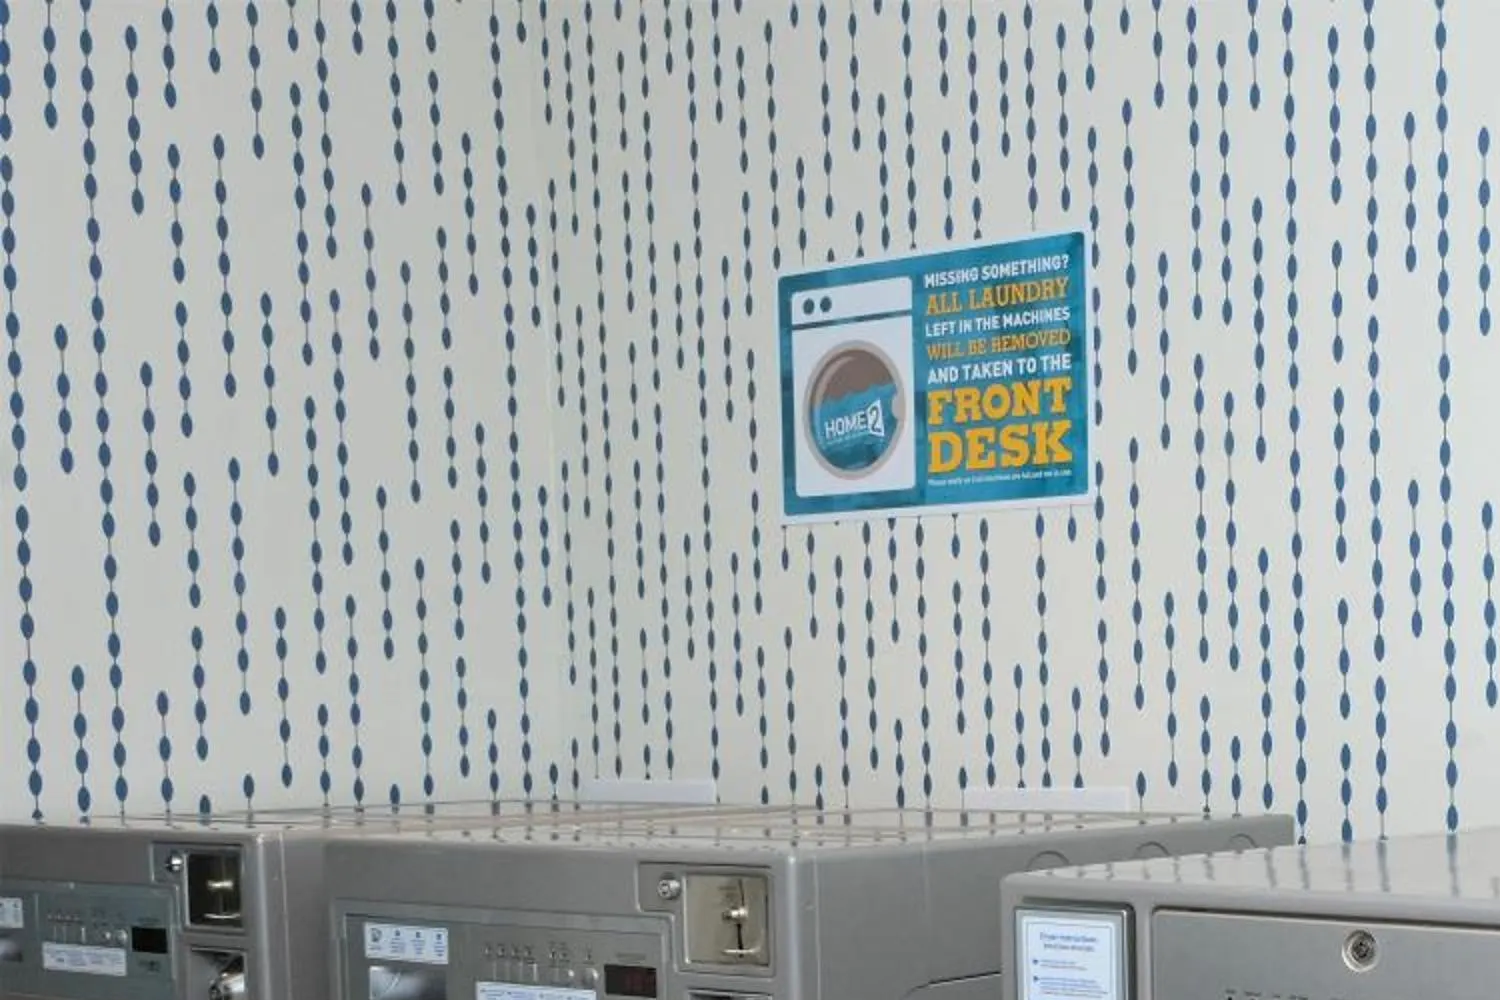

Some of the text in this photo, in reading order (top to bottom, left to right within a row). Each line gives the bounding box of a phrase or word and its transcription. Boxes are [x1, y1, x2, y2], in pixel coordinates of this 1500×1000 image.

[924, 254, 1070, 288] MISSING SOMETHING?
[927, 276, 1069, 315] ALL LAUNDRY
[925, 307, 1070, 337] LEFT IN THE MACHINES
[928, 329, 1071, 360] WILL BE REMOVED
[928, 353, 1073, 385] AND TAKEN TO THE
[928, 376, 1072, 425] FRONT
[928, 420, 1073, 473] DESK
